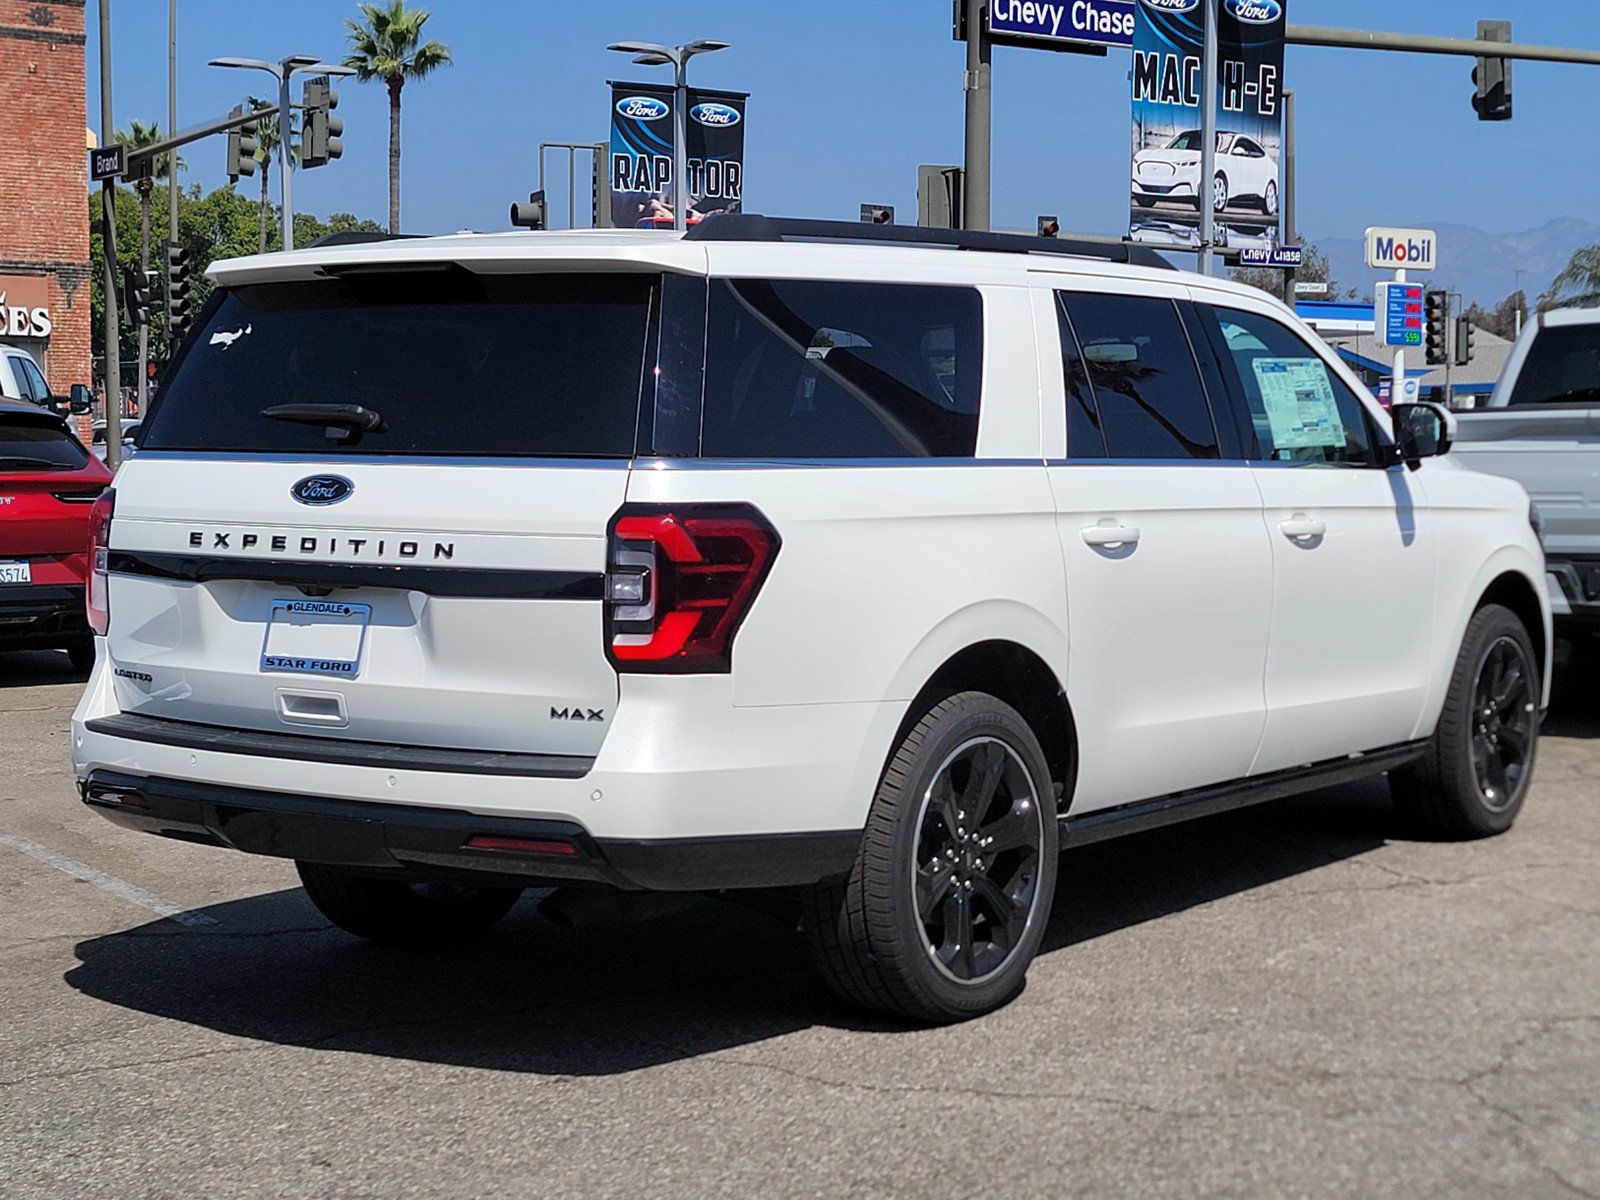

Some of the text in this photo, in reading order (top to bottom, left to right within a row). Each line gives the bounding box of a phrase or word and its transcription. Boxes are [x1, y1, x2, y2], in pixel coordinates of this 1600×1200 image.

[994, 0, 1134, 35] Chevy Chase
[1235, 0, 1270, 19] Ford
[1133, 50, 1277, 116] MAC H-E
[627, 100, 658, 117] Ford
[700, 107, 730, 124] Ford
[97, 151, 118, 173] Brand
[1242, 249, 1271, 264] Chevy
[1376, 237, 1430, 262] Mobil
[301, 479, 338, 498] Ford
[189, 531, 455, 559] EXPEDITION
[293, 602, 344, 615] GLENDALE
[265, 656, 352, 673] STAR FORD
[550, 706, 605, 722] MAX
